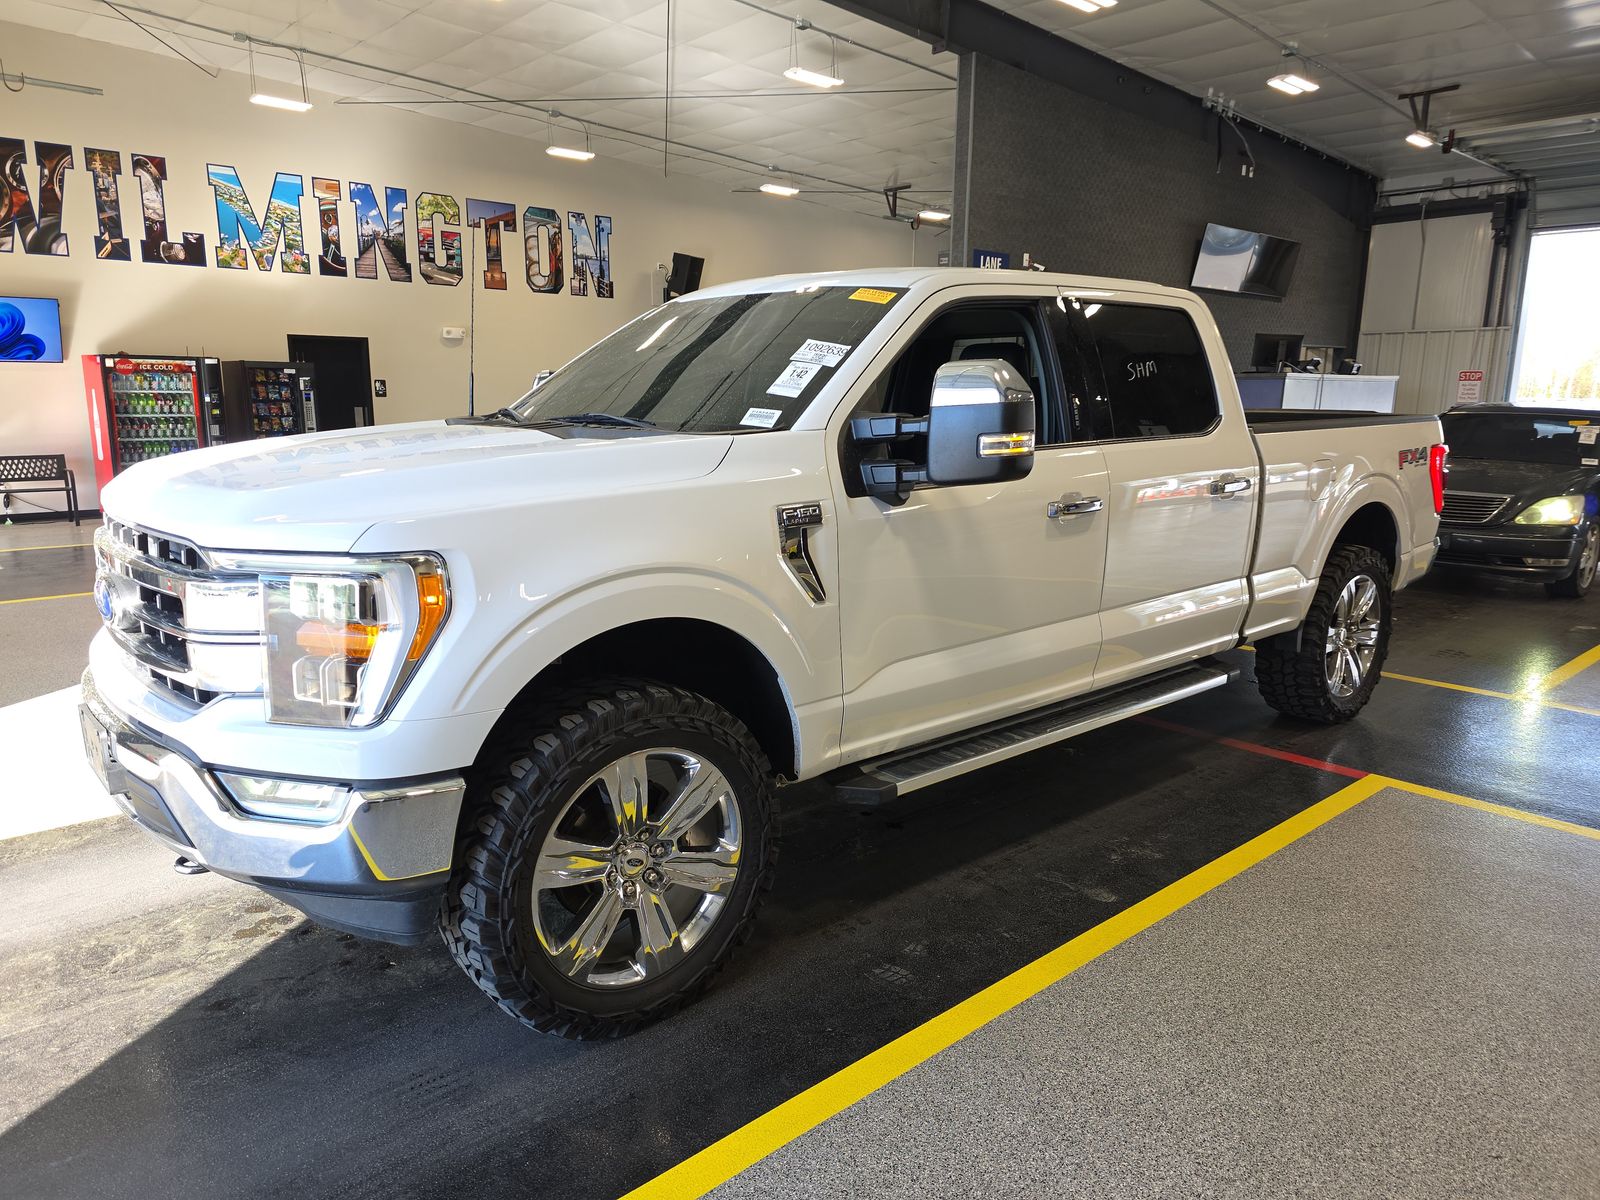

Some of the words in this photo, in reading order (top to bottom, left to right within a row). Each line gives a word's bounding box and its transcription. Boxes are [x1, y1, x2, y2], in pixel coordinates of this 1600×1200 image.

[0, 136, 614, 299] WILMINGTON
[980, 255, 1002, 269] LANE
[803, 342, 849, 357] 1092639
[790, 369, 808, 379] 1:42
[1127, 360, 1158, 381] SHM
[1460, 372, 1482, 380] STOP
[1398, 446, 1428, 470] FX4
[782, 506, 819, 522] F-150
